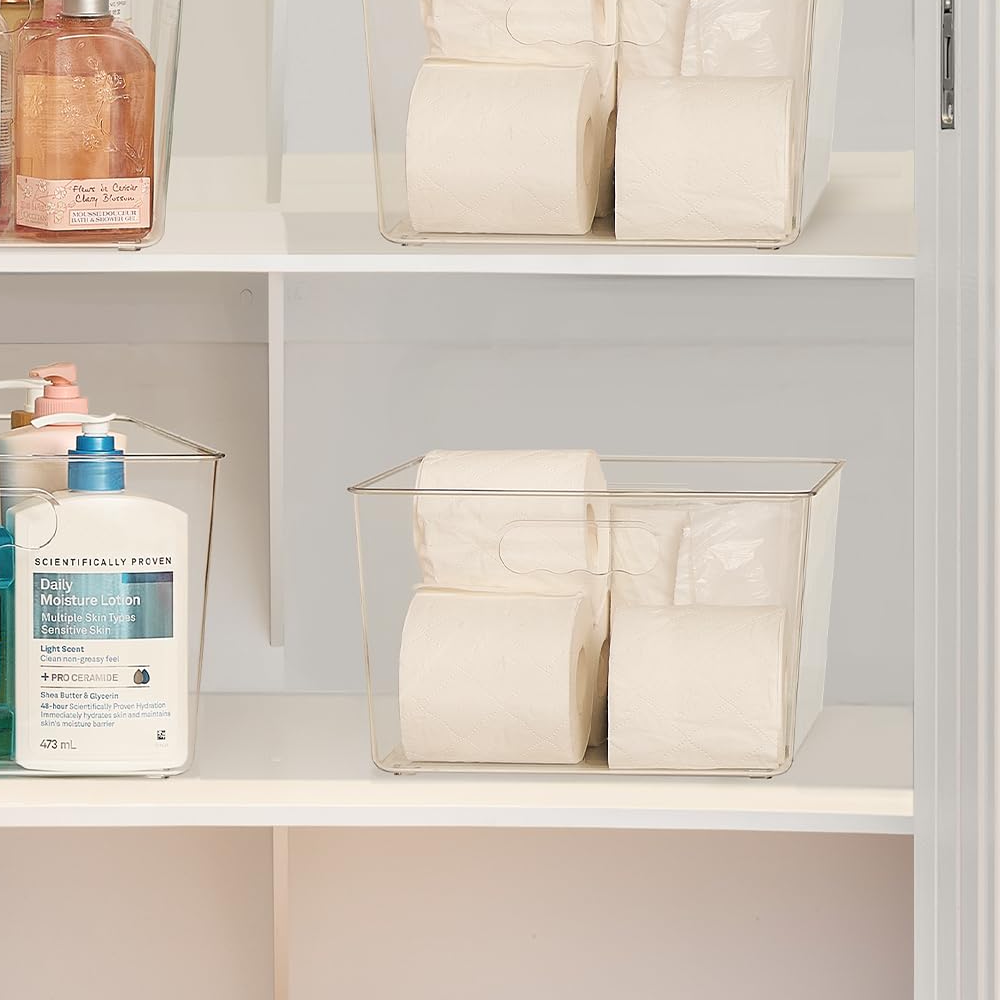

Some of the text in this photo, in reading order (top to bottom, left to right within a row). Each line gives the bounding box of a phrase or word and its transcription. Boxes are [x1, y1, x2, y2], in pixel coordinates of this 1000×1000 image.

[34, 557, 172, 566] SCIENTIFICALLY PROVEN
[40, 578, 73, 593] Daily
[40, 593, 141, 606] Moisture Lotion
[41, 612, 136, 624] Multiple Skin Types
[40, 625, 111, 635] Sensitive Skin
[40, 645, 85, 654] Light Scent
[62, 655, 104, 664] non-greasy
[105, 655, 120, 663] feel
[51, 674, 70, 682] PRO
[71, 673, 119, 682] CERAMIDE
[40, 691, 59, 699] Shea
[60, 691, 82, 699] Butter
[89, 692, 119, 701] Glycerin
[136, 702, 166, 710] Hydration
[40, 711, 82, 720] Immediately
[83, 711, 112, 720] hydrates
[113, 711, 126, 719] skin
[92, 720, 115, 728] barrier
[39, 739, 77, 750] 473 mL
